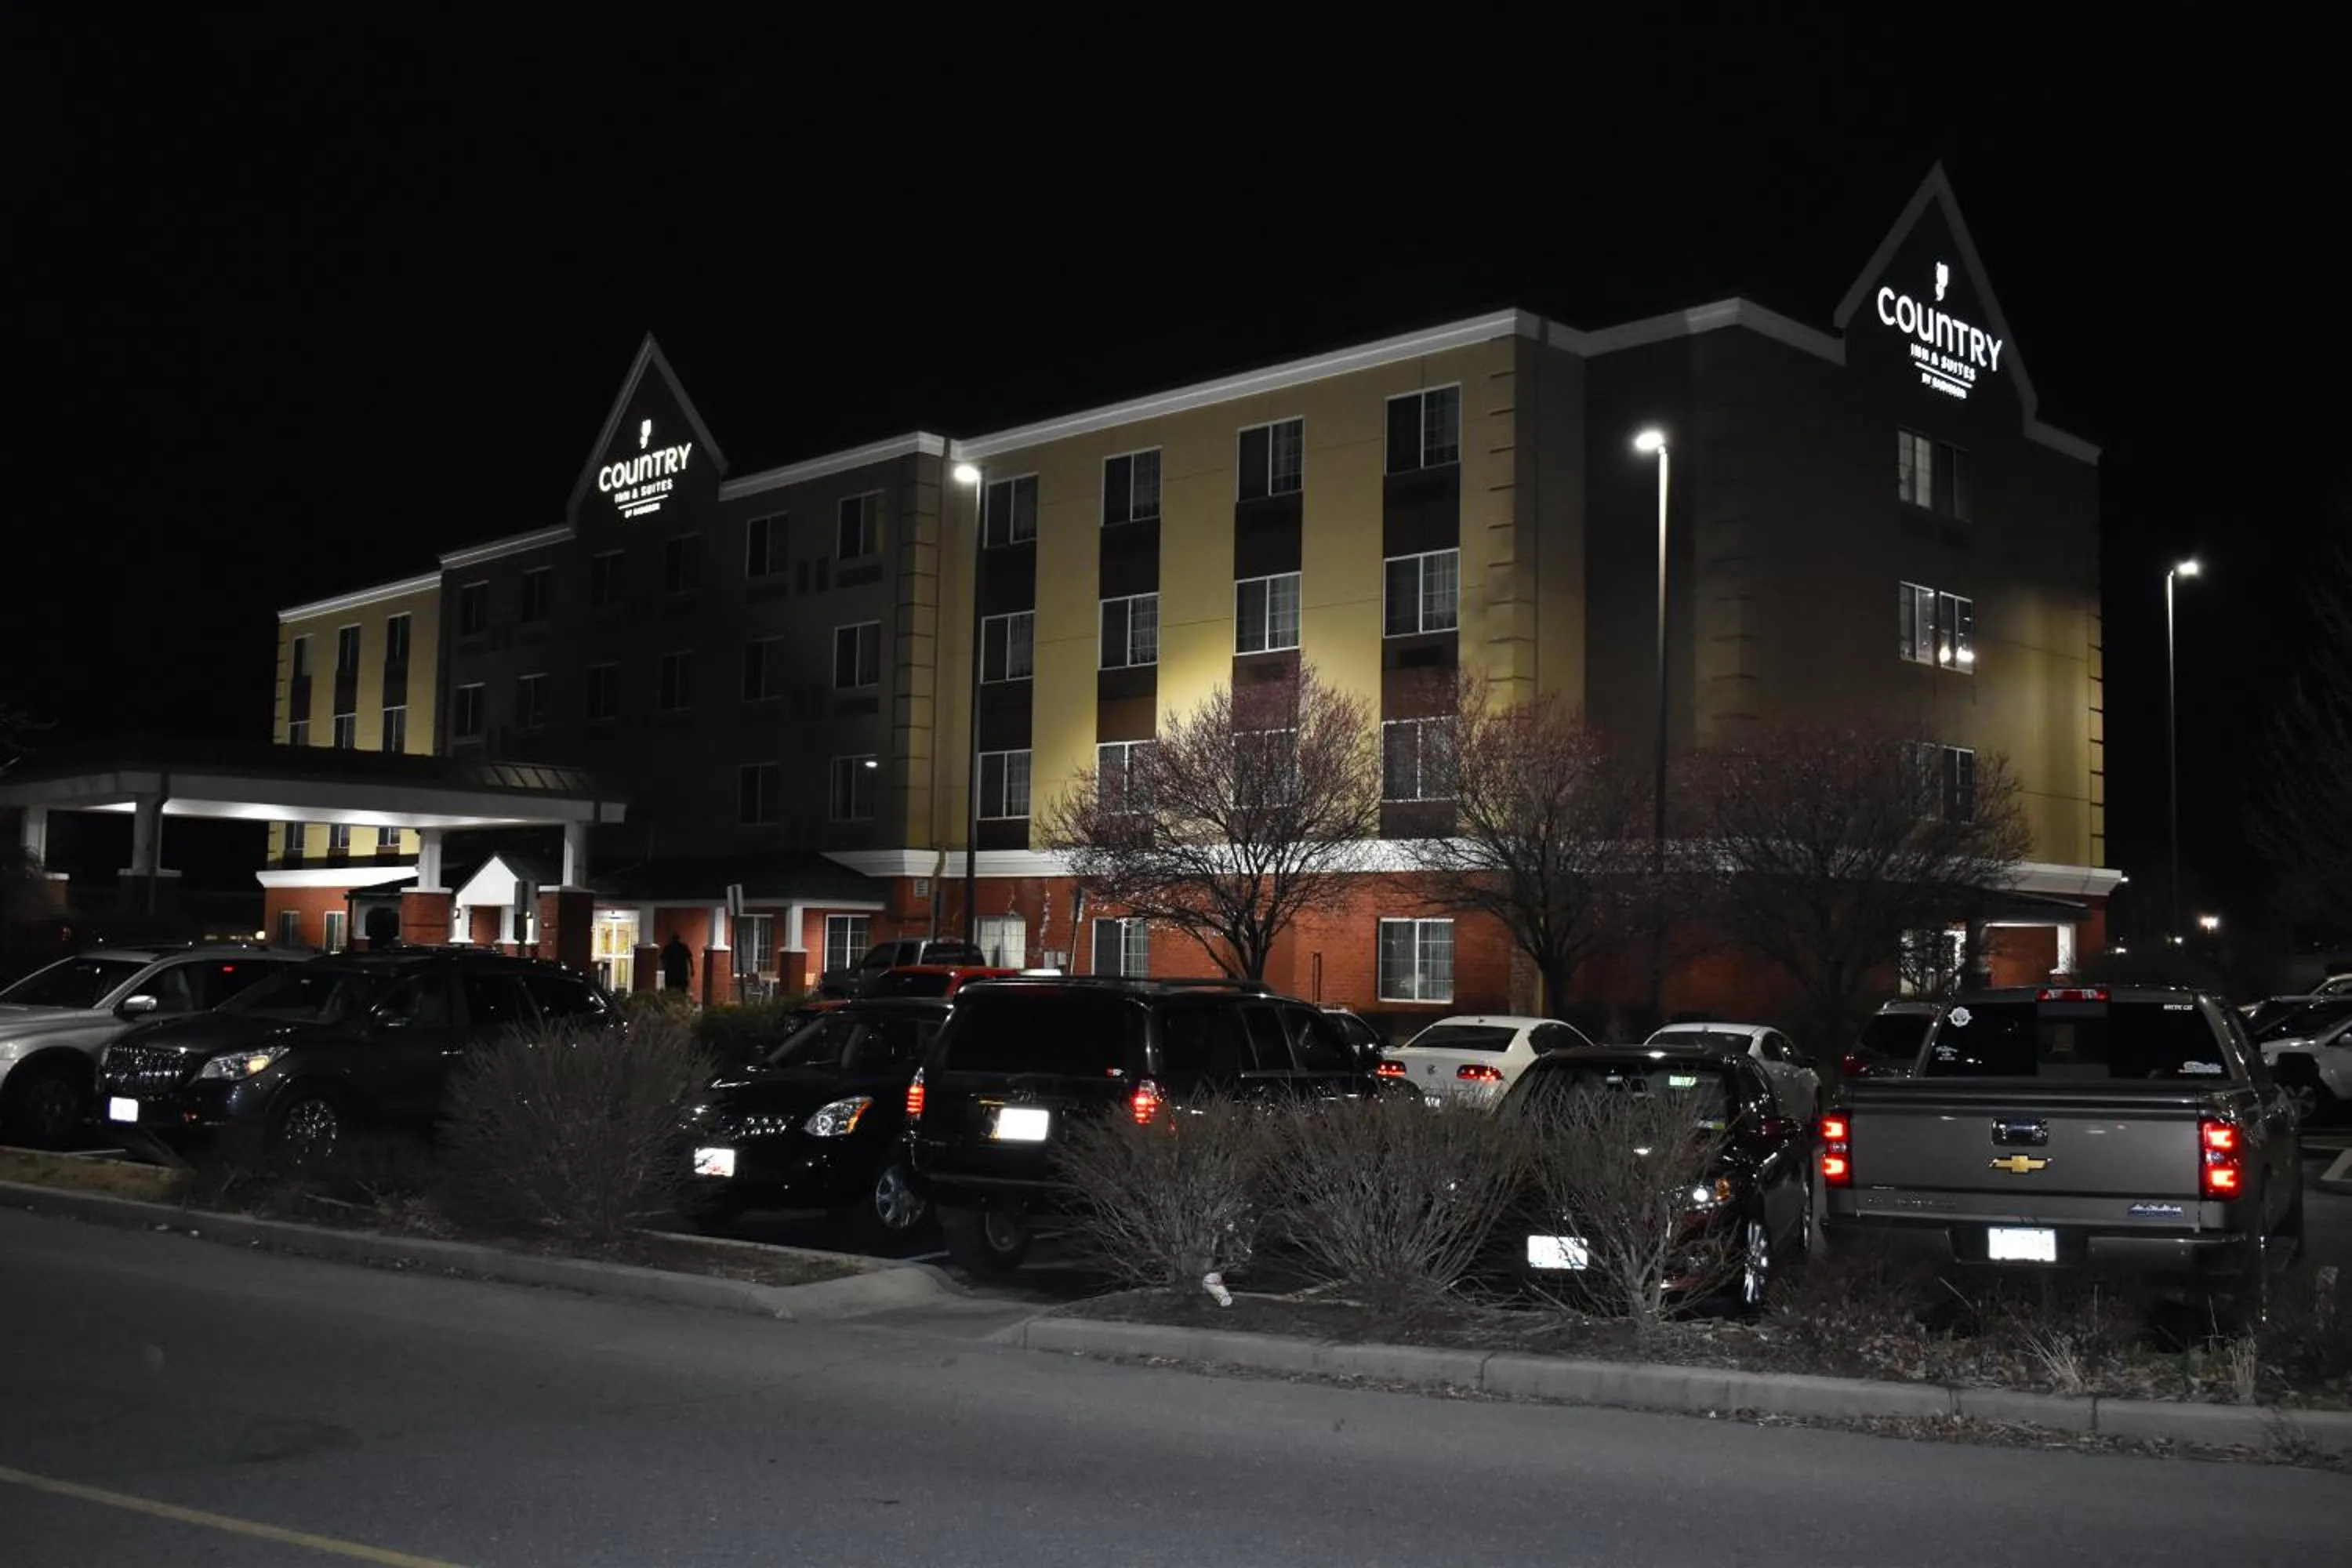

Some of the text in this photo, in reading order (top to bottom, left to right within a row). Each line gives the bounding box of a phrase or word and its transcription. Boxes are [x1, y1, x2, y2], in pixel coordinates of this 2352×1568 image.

[1877, 286, 2003, 372] COUNTRY
[1940, 355, 1976, 382] SUITES
[598, 441, 692, 492] COUNTRY
[641, 477, 673, 497] SUITES
